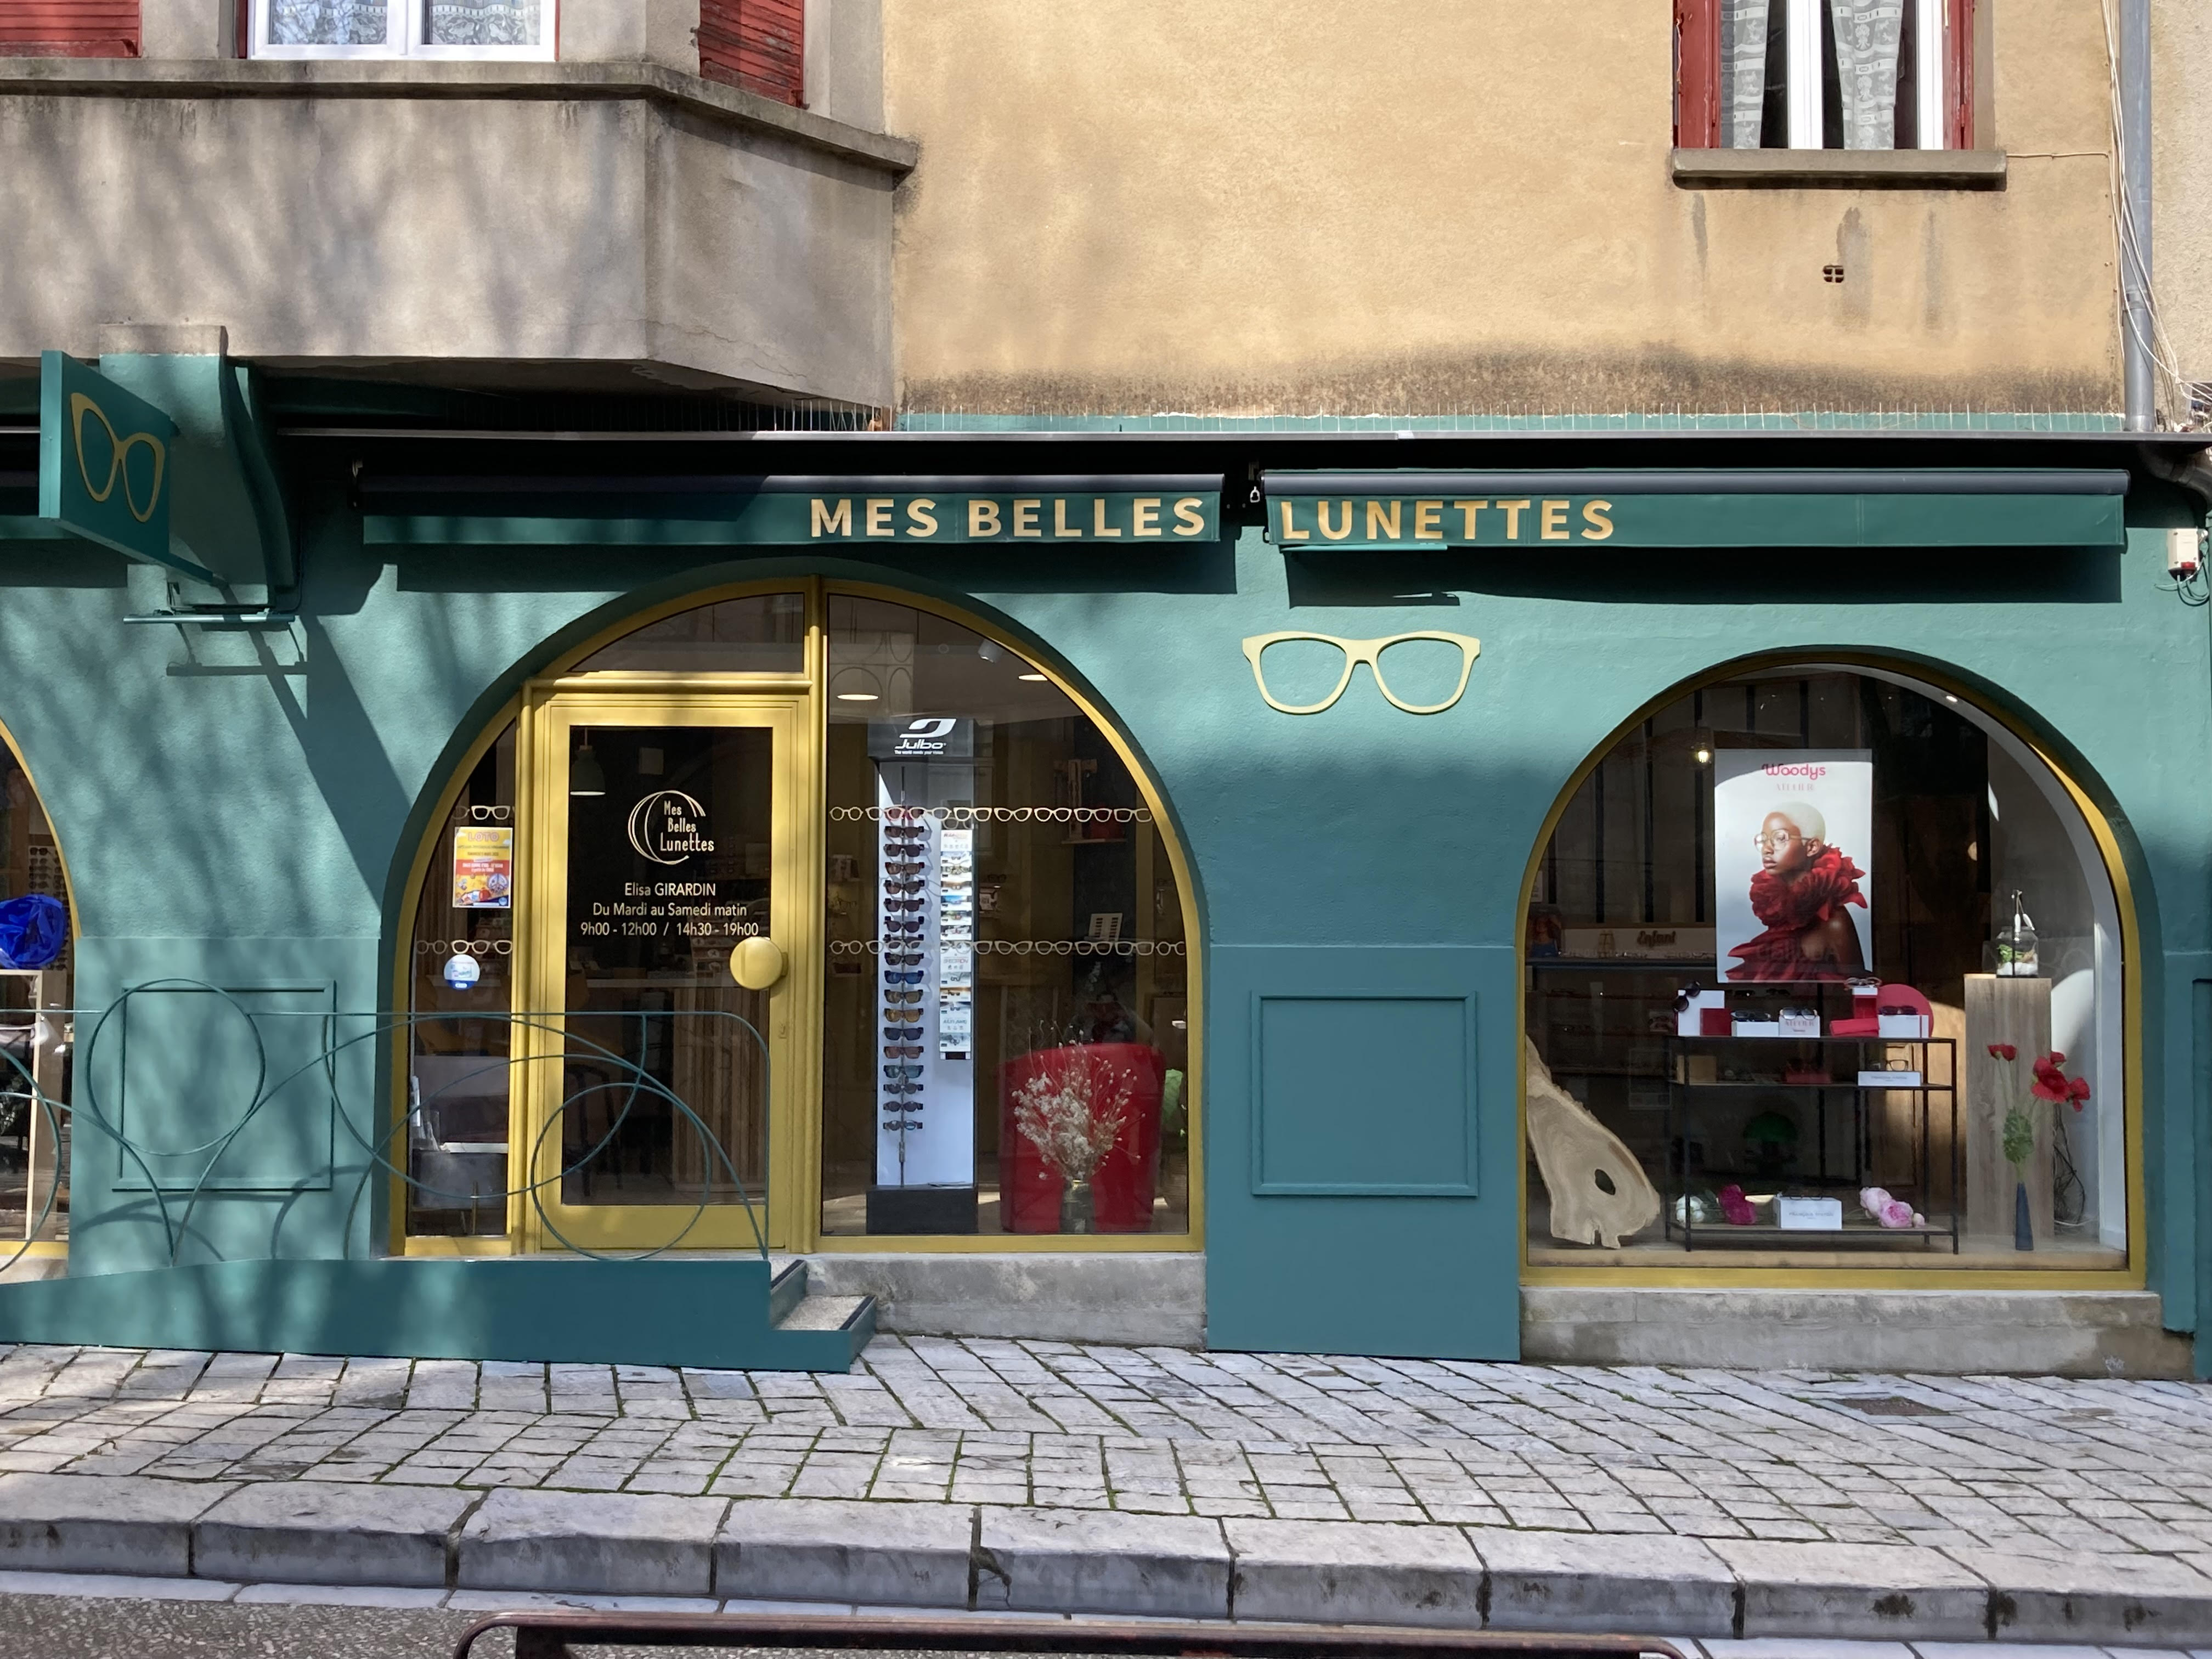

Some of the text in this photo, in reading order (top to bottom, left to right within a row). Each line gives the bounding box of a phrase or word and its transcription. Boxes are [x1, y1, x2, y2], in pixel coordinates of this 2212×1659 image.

[811, 498, 1205, 538] MES BELLES
[1281, 500, 1614, 540] LUNETTES
[894, 738, 944, 749] Julbo
[1762, 763, 1826, 780] Woodys
[664, 800, 682, 816] Mes
[668, 817, 697, 833] Belles
[468, 832, 500, 842] LOTO
[660, 832, 714, 851] Lunettes
[624, 883, 716, 896] Elisa GIRARDIN
[593, 902, 747, 916] Du Mardi au Samedi matin
[580, 922, 610, 936] 9h00
[622, 922, 657, 936] 12h00
[663, 922, 669, 936] /
[676, 922, 712, 936] 14h30
[723, 922, 759, 936] 19h00
